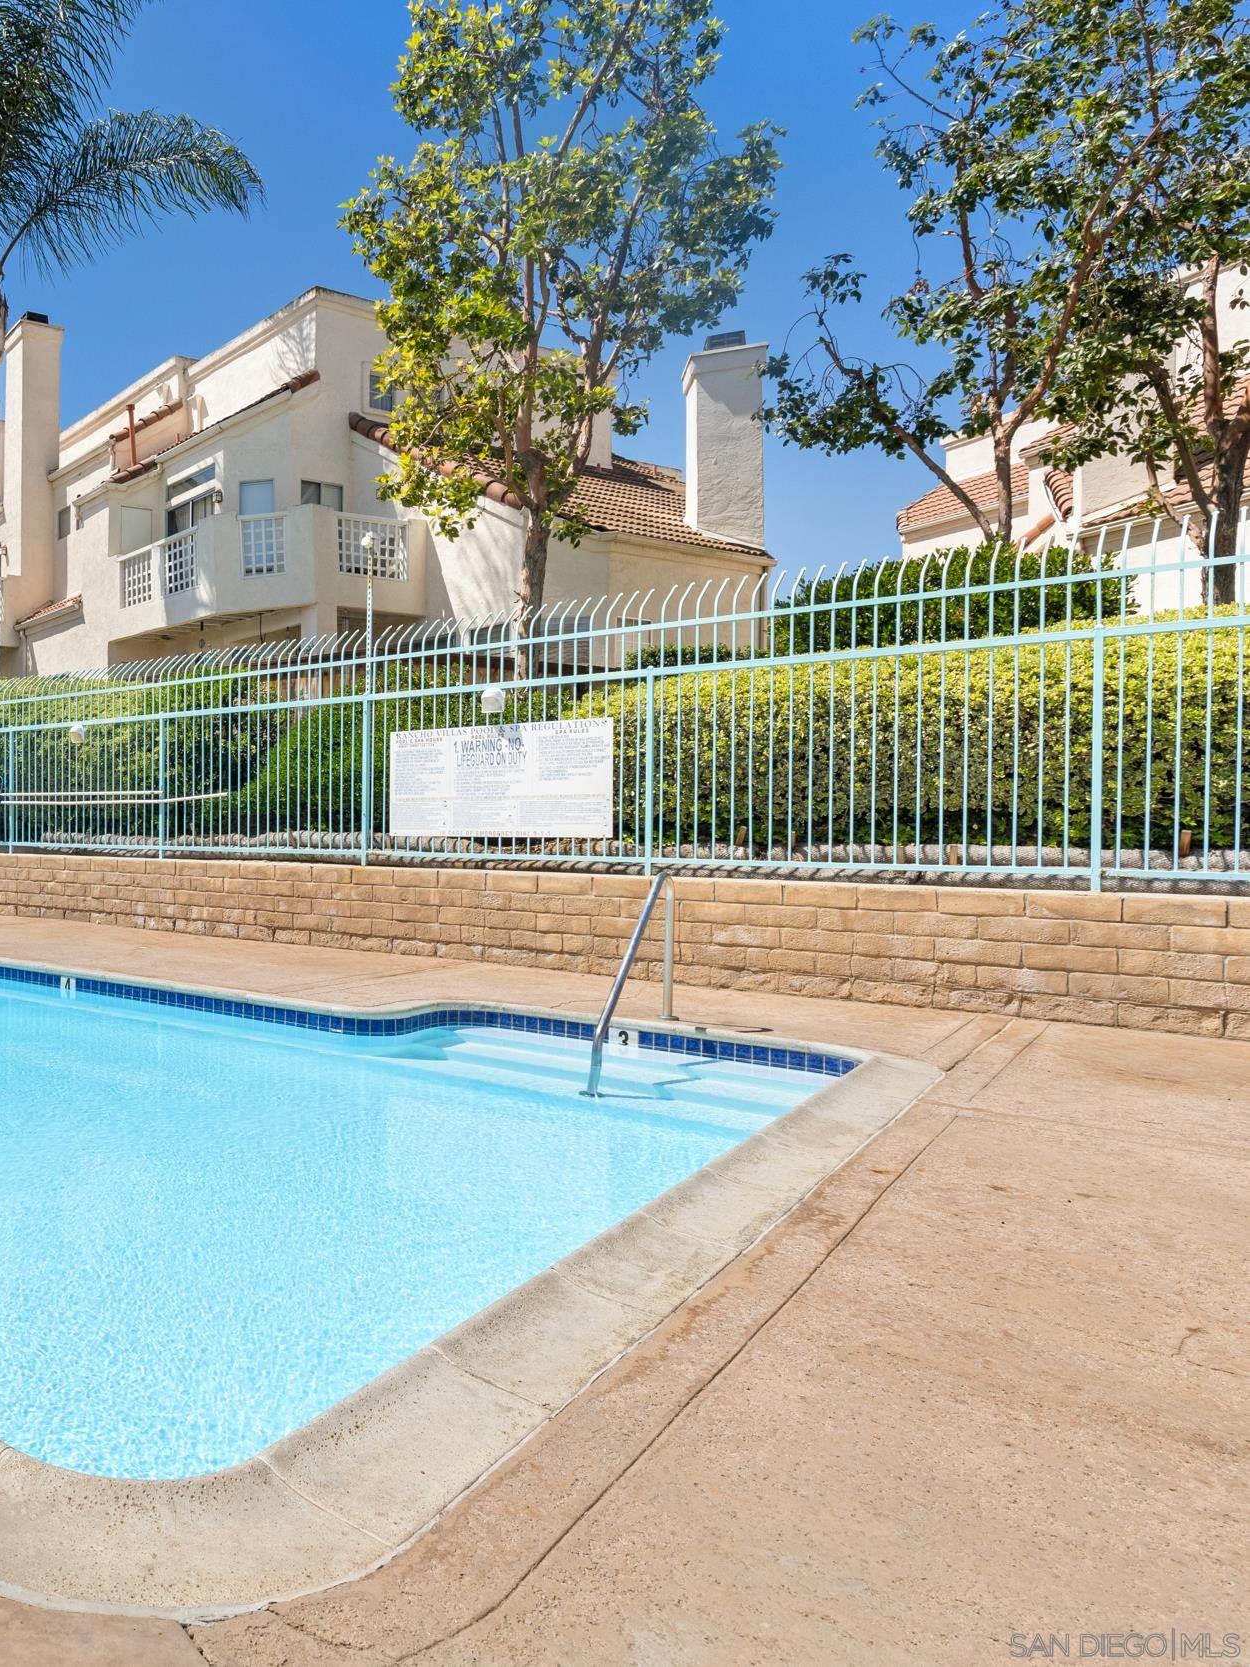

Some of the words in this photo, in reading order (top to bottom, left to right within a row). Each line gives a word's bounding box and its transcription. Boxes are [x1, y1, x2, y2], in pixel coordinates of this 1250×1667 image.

[396, 731, 433, 740] RANCHO
[436, 728, 467, 737] VILLAS
[471, 726, 495, 734] POOL
[510, 724, 527, 733] SPA
[531, 719, 607, 731] REGULATIONS
[461, 738, 502, 753] WARNING
[457, 752, 495, 767] LIFEGUARD
[496, 752, 506, 766] ON
[508, 751, 527, 765] DUTY
[618, 1030, 629, 1046] 3
